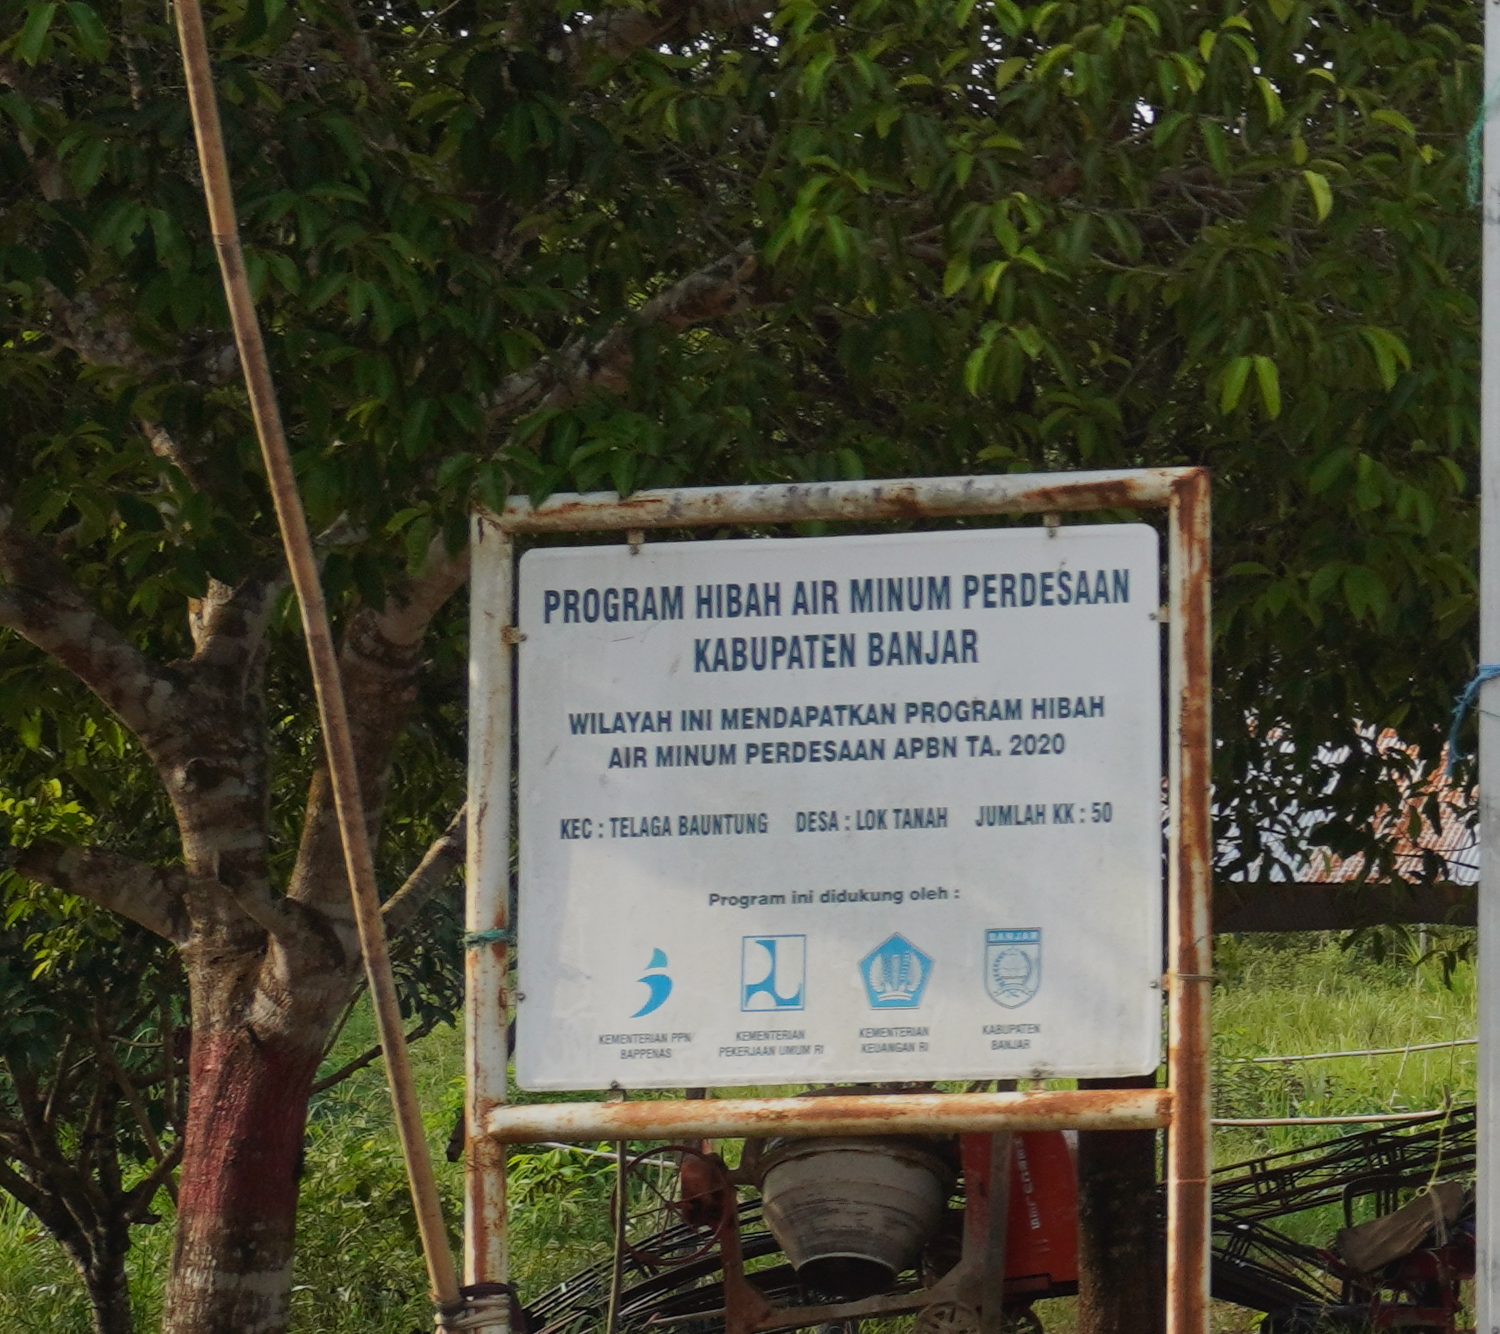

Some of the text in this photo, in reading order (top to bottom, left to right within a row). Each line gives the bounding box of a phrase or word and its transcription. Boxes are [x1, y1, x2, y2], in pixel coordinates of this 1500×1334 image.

[544, 569, 1129, 624] PROGRAM HIBAH AIR MINUM PERDESAAN
[695, 629, 978, 672] KABUPATEN BANJAR
[569, 696, 1104, 735] WILAYAH INI MENDAPATKAN PROGRAM HIBAH
[608, 733, 1065, 768] AIR MINUM PERDESAAN APBN TA. 2020
[560, 818, 592, 839] KEC
[609, 816, 672, 838] TELAGA
[678, 813, 768, 836] BAUNTUNG
[796, 811, 839, 833] DESA
[856, 809, 887, 831] LOK
[892, 807, 947, 829] TANAH
[975, 804, 1046, 827] JUMLAH
[1053, 803, 1074, 824] KK
[1091, 802, 1113, 823] 50
[709, 890, 786, 909] Program
[791, 890, 814, 907] ini
[819, 889, 904, 905] didukung
[909, 886, 948, 901] oleh
[599, 1033, 668, 1045] KEMENTERIAN
[736, 1030, 805, 1041] KEMENTERIAN
[982, 1024, 1041, 1035] KABUPATEN
[620, 1048, 672, 1059] BAPPENAS
[719, 1046, 775, 1057] PEKERJAAN
